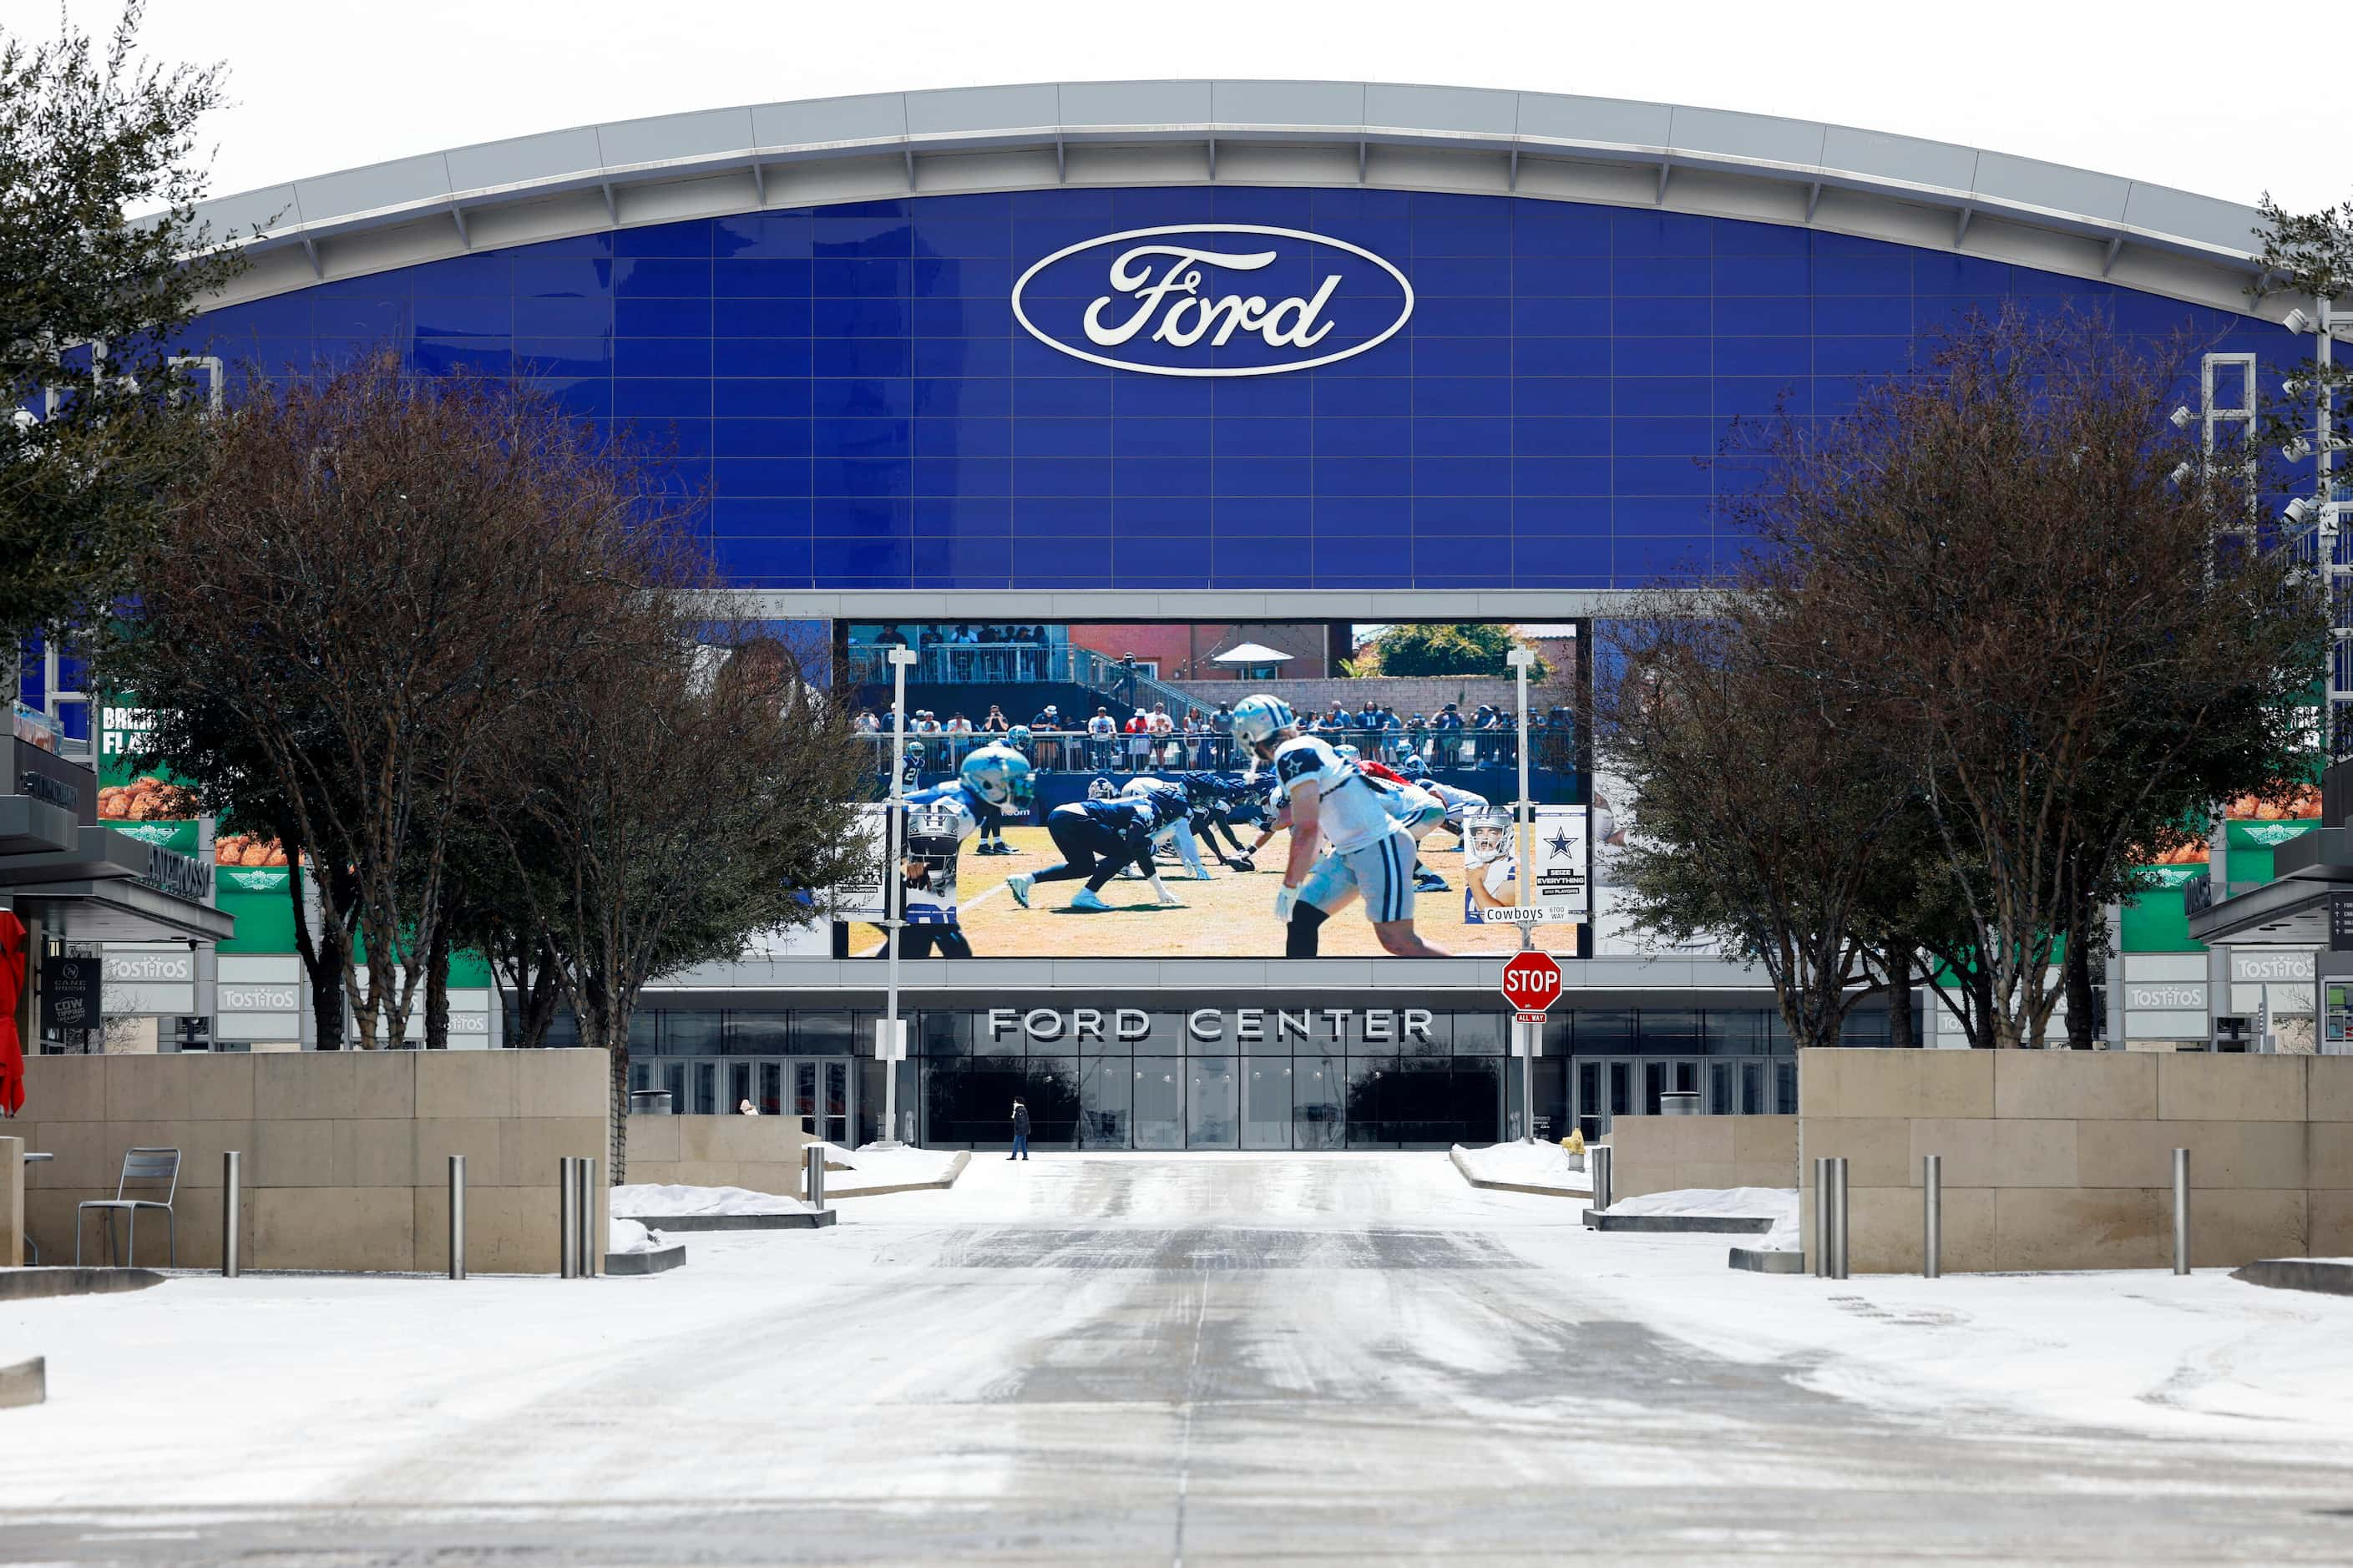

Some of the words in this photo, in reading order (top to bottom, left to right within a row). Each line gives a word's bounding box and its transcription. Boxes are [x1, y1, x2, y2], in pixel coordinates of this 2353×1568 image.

[1083, 245, 1343, 348] Ford
[1487, 908, 1543, 921] Cowboys
[1506, 969, 1558, 992] STOP
[54, 998, 83, 1011] COW
[988, 1009, 1151, 1036] FORD
[1189, 1009, 1434, 1036] CENTER
